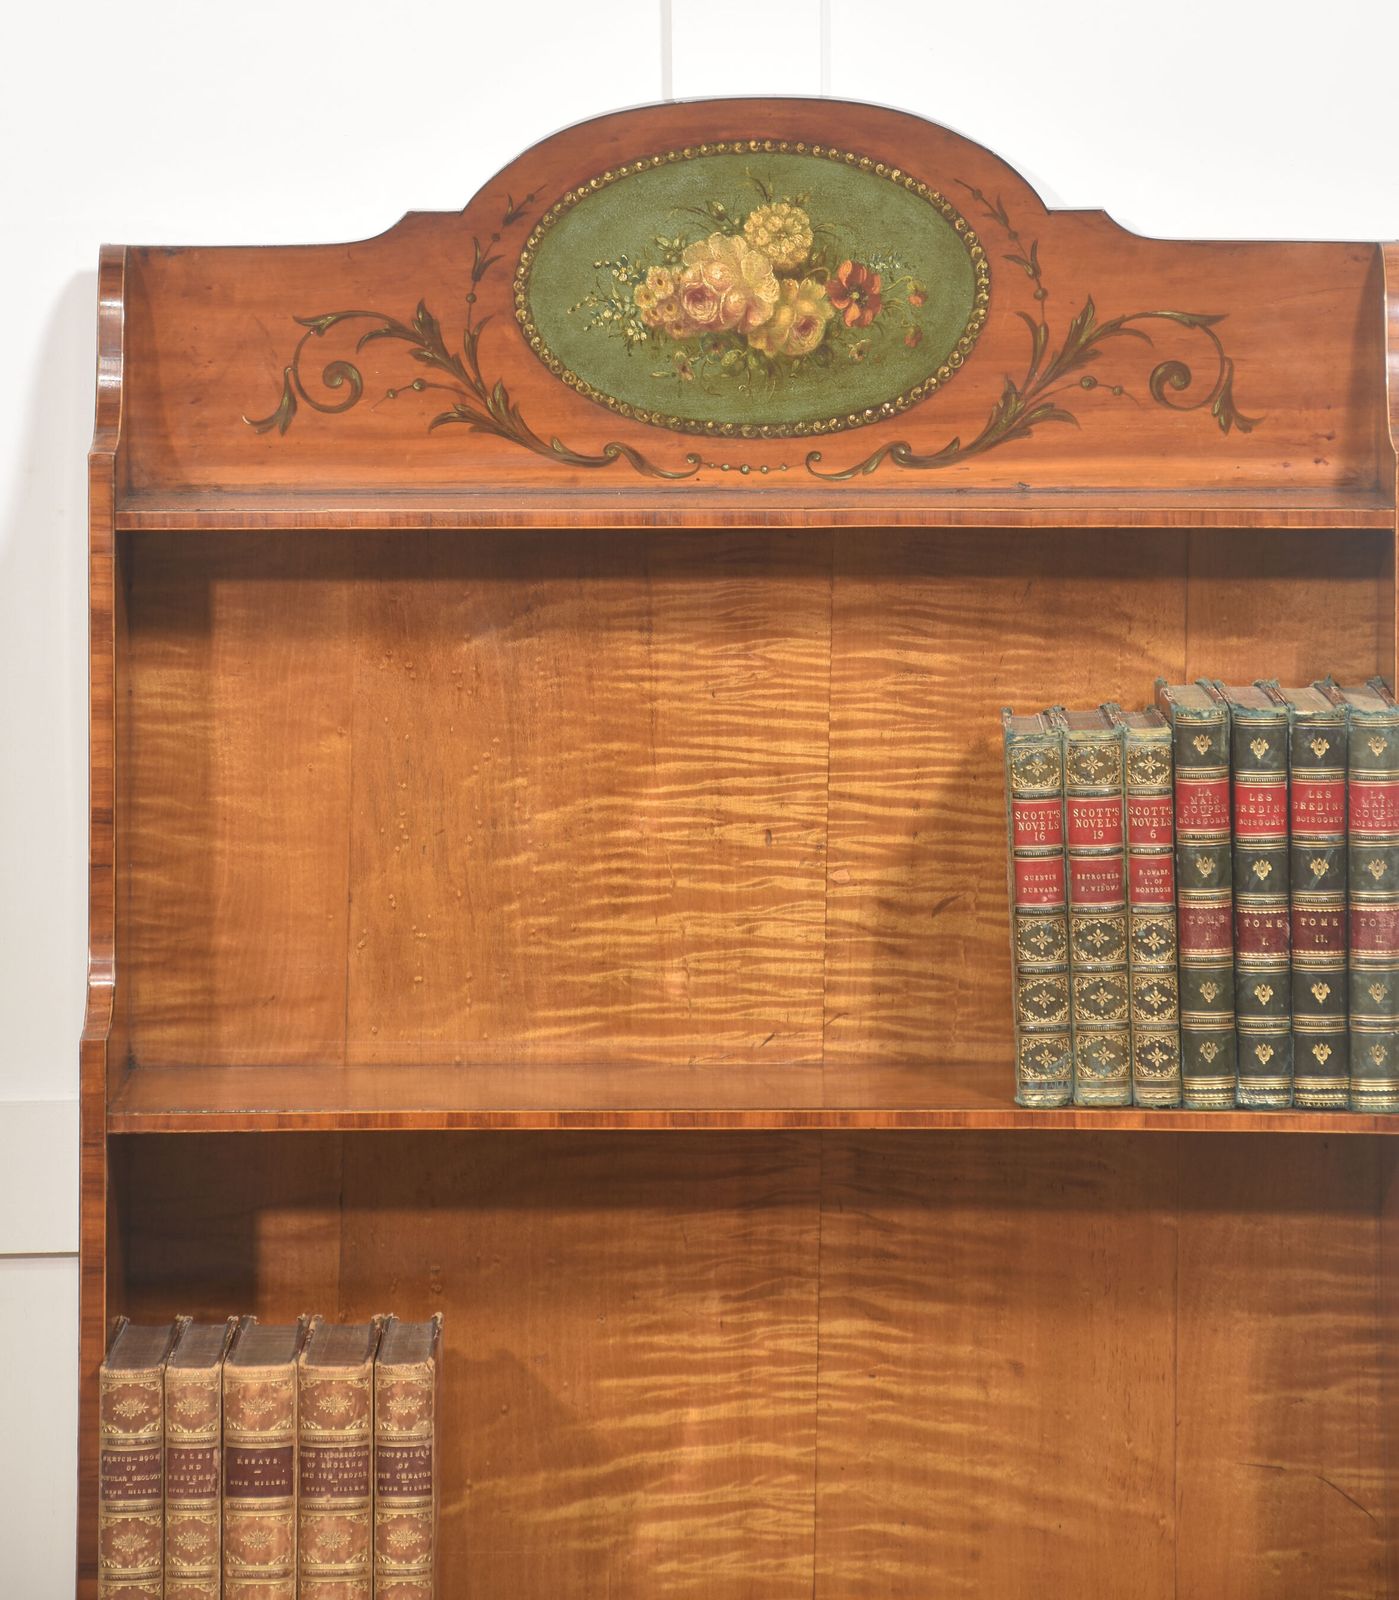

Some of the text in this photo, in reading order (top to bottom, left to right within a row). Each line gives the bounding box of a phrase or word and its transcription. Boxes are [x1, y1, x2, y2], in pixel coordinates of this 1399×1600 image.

[1198, 788, 1212, 796] LA
[1370, 791, 1385, 799] LA
[1249, 793, 1272, 801] LES
[1361, 799, 1393, 807] MAIN
[1015, 810, 1061, 820] SCOTT'S
[1073, 808, 1120, 817] SCOTT'S
[1129, 807, 1173, 815] SCOTT'S
[1018, 822, 1059, 831] NOVELS
[1076, 819, 1118, 828] NOVELS
[1132, 818, 1172, 827] NOVELS
[1034, 832, 1046, 841] 16
[1093, 830, 1104, 839] 19
[1150, 830, 1156, 838] 6
[1244, 919, 1283, 928] TOME
[1300, 918, 1338, 926] TOME
[1315, 934, 1328, 943] II.
